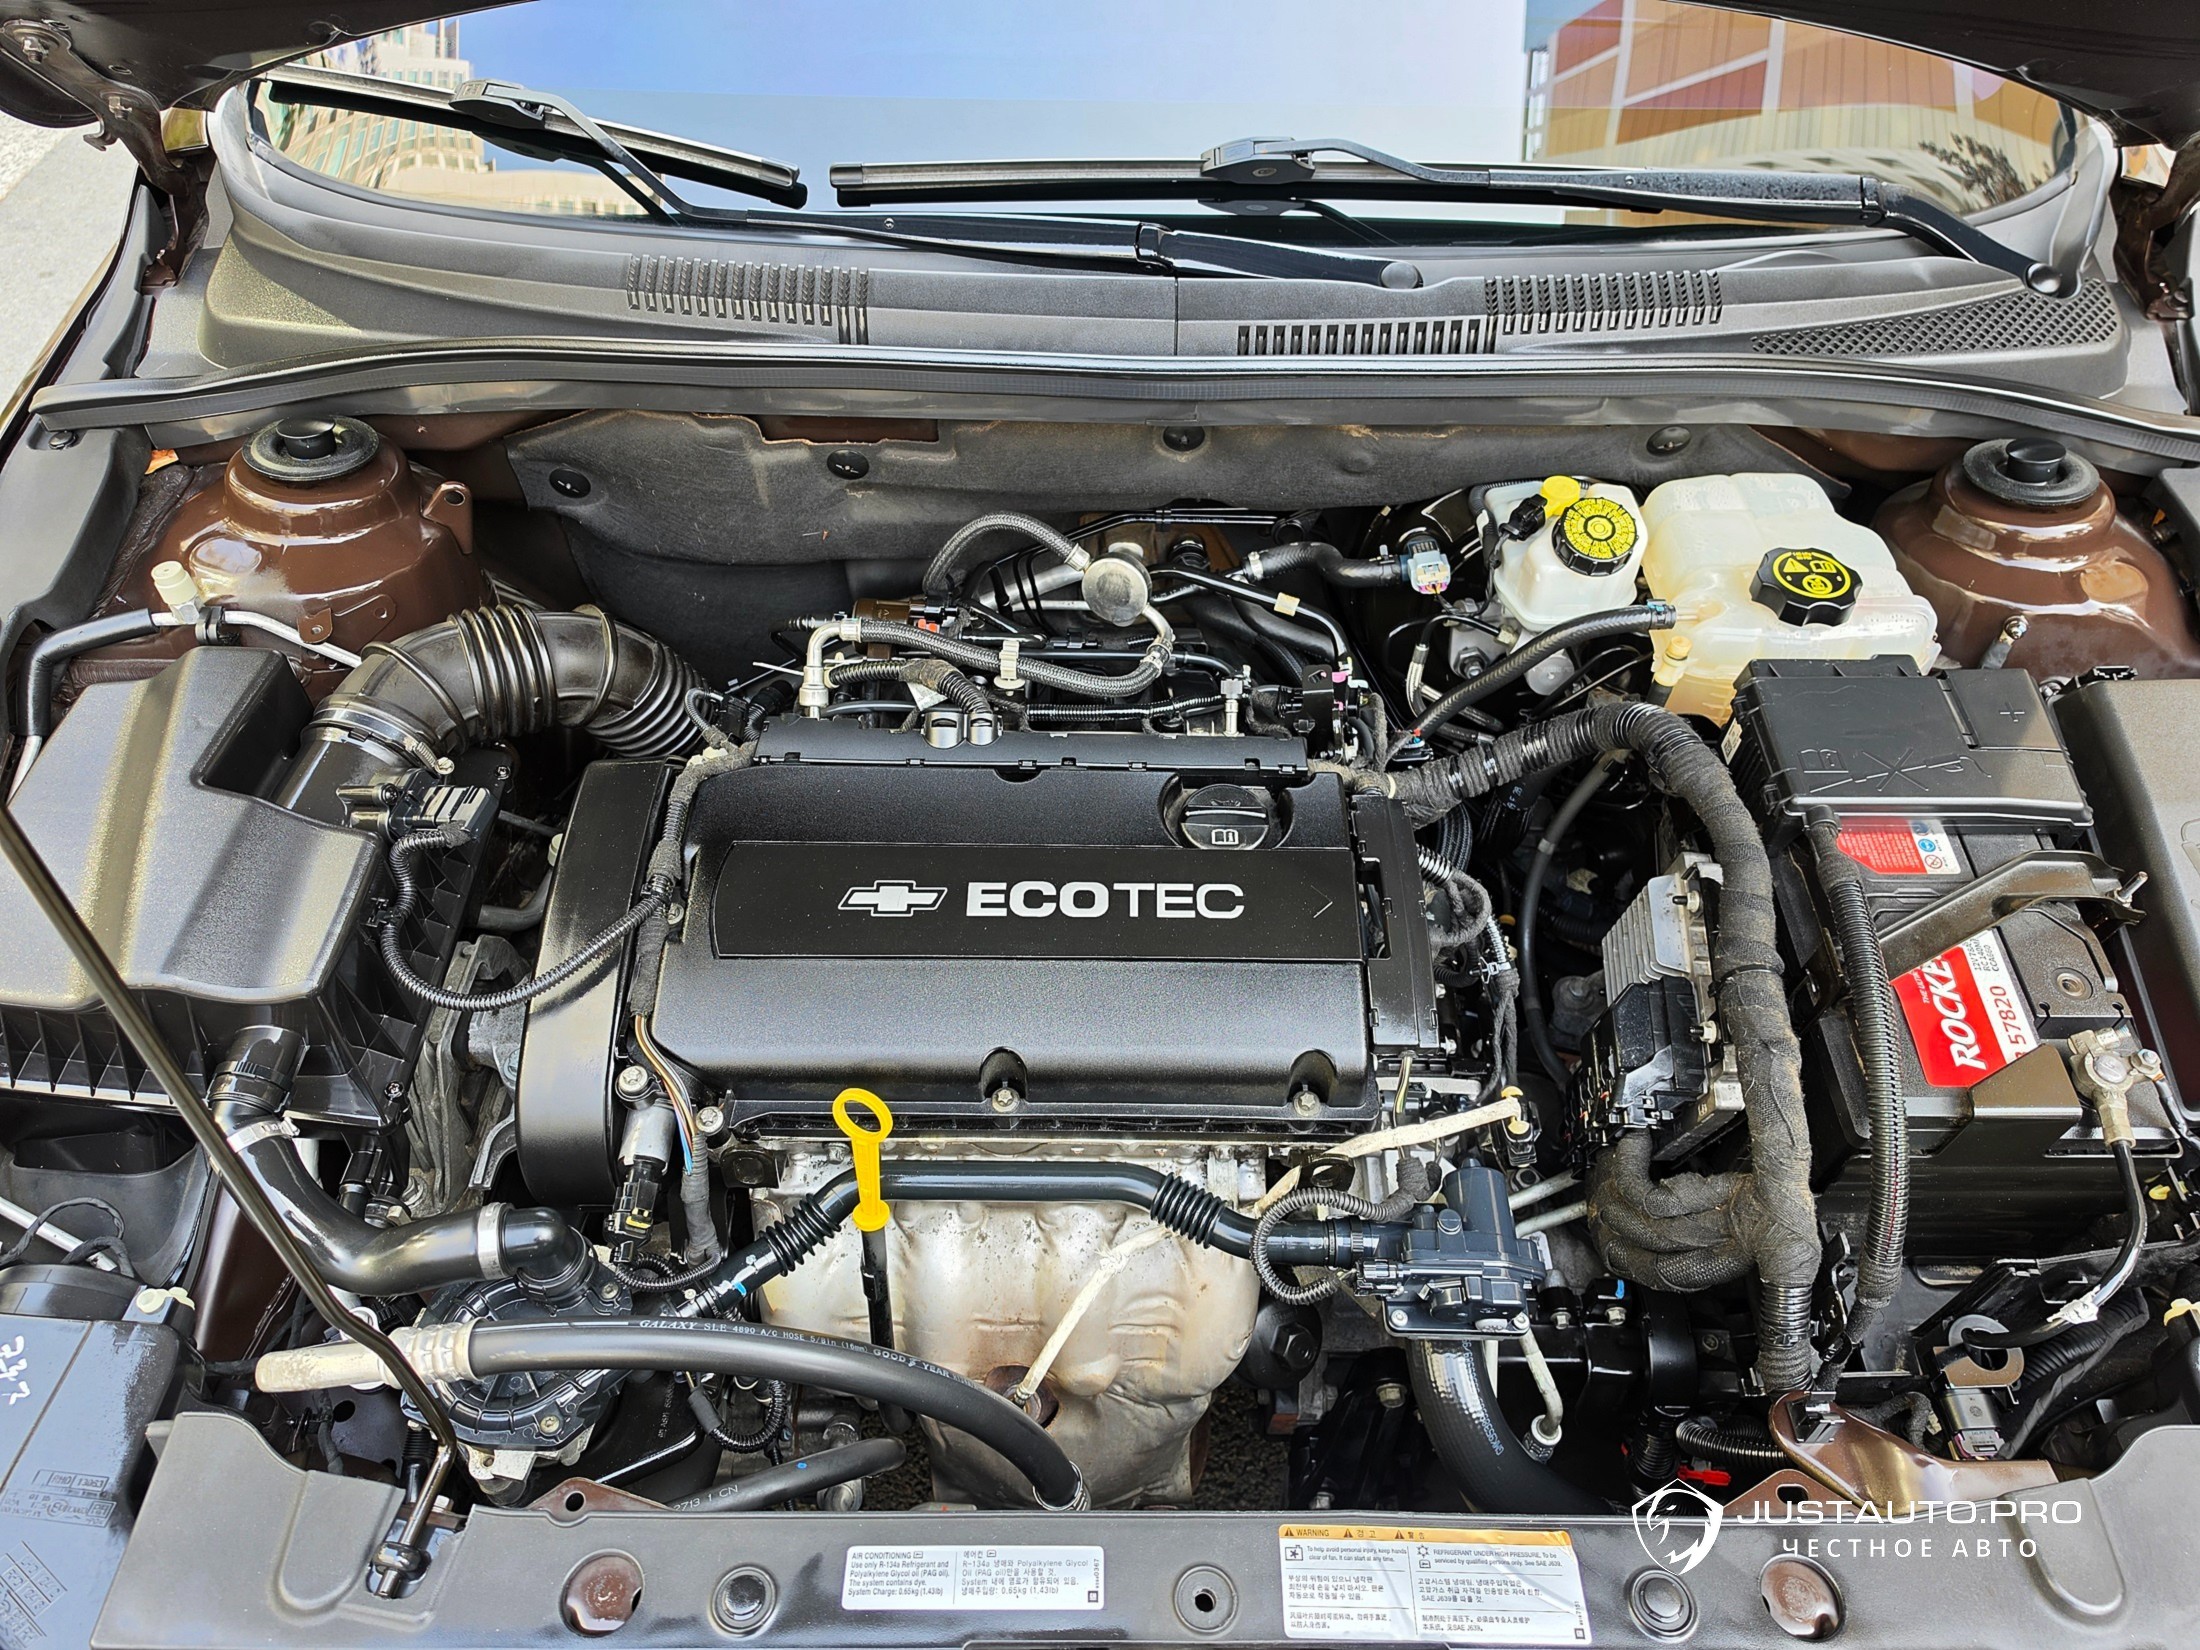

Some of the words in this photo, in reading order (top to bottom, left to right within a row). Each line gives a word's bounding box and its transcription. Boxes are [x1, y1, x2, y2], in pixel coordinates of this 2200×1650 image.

[966, 881, 1244, 919] ECOTEC
[1921, 955, 1988, 1071] ROCKE
[1990, 985, 2027, 1046] 57820
[639, 1319, 698, 1330] GALAXY
[704, 1322, 727, 1332] SLE
[783, 1331, 805, 1342] HOSE
[719, 1485, 739, 1498] CN
[1296, 1529, 1330, 1537] WARNING
[852, 1552, 863, 1560] AIR
[864, 1552, 911, 1560] CONDITIONING
[963, 1550, 983, 1559] 에어컨
[851, 1560, 863, 1568] Use
[864, 1561, 877, 1570] only
[879, 1560, 900, 1568] R-134a
[901, 1560, 936, 1570] Refrigerant
[937, 1560, 949, 1568] and
[963, 1560, 990, 1568] R-134a
[1017, 1560, 1062, 1568] Polyalkylene
[1065, 1560, 1088, 1568] Glycol
[849, 1570, 889, 1579] Polyalkylene
[890, 1570, 910, 1578] Glycol
[911, 1569, 919, 1577] oil
[920, 1569, 937, 1577] (PAG
[962, 1569, 971, 1577] Oil
[975, 1569, 992, 1577] (PAG
[862, 1579, 884, 1588] system
[962, 1578, 988, 1587] System
[848, 1588, 871, 1597] System
[873, 1588, 897, 1597] Charge:
